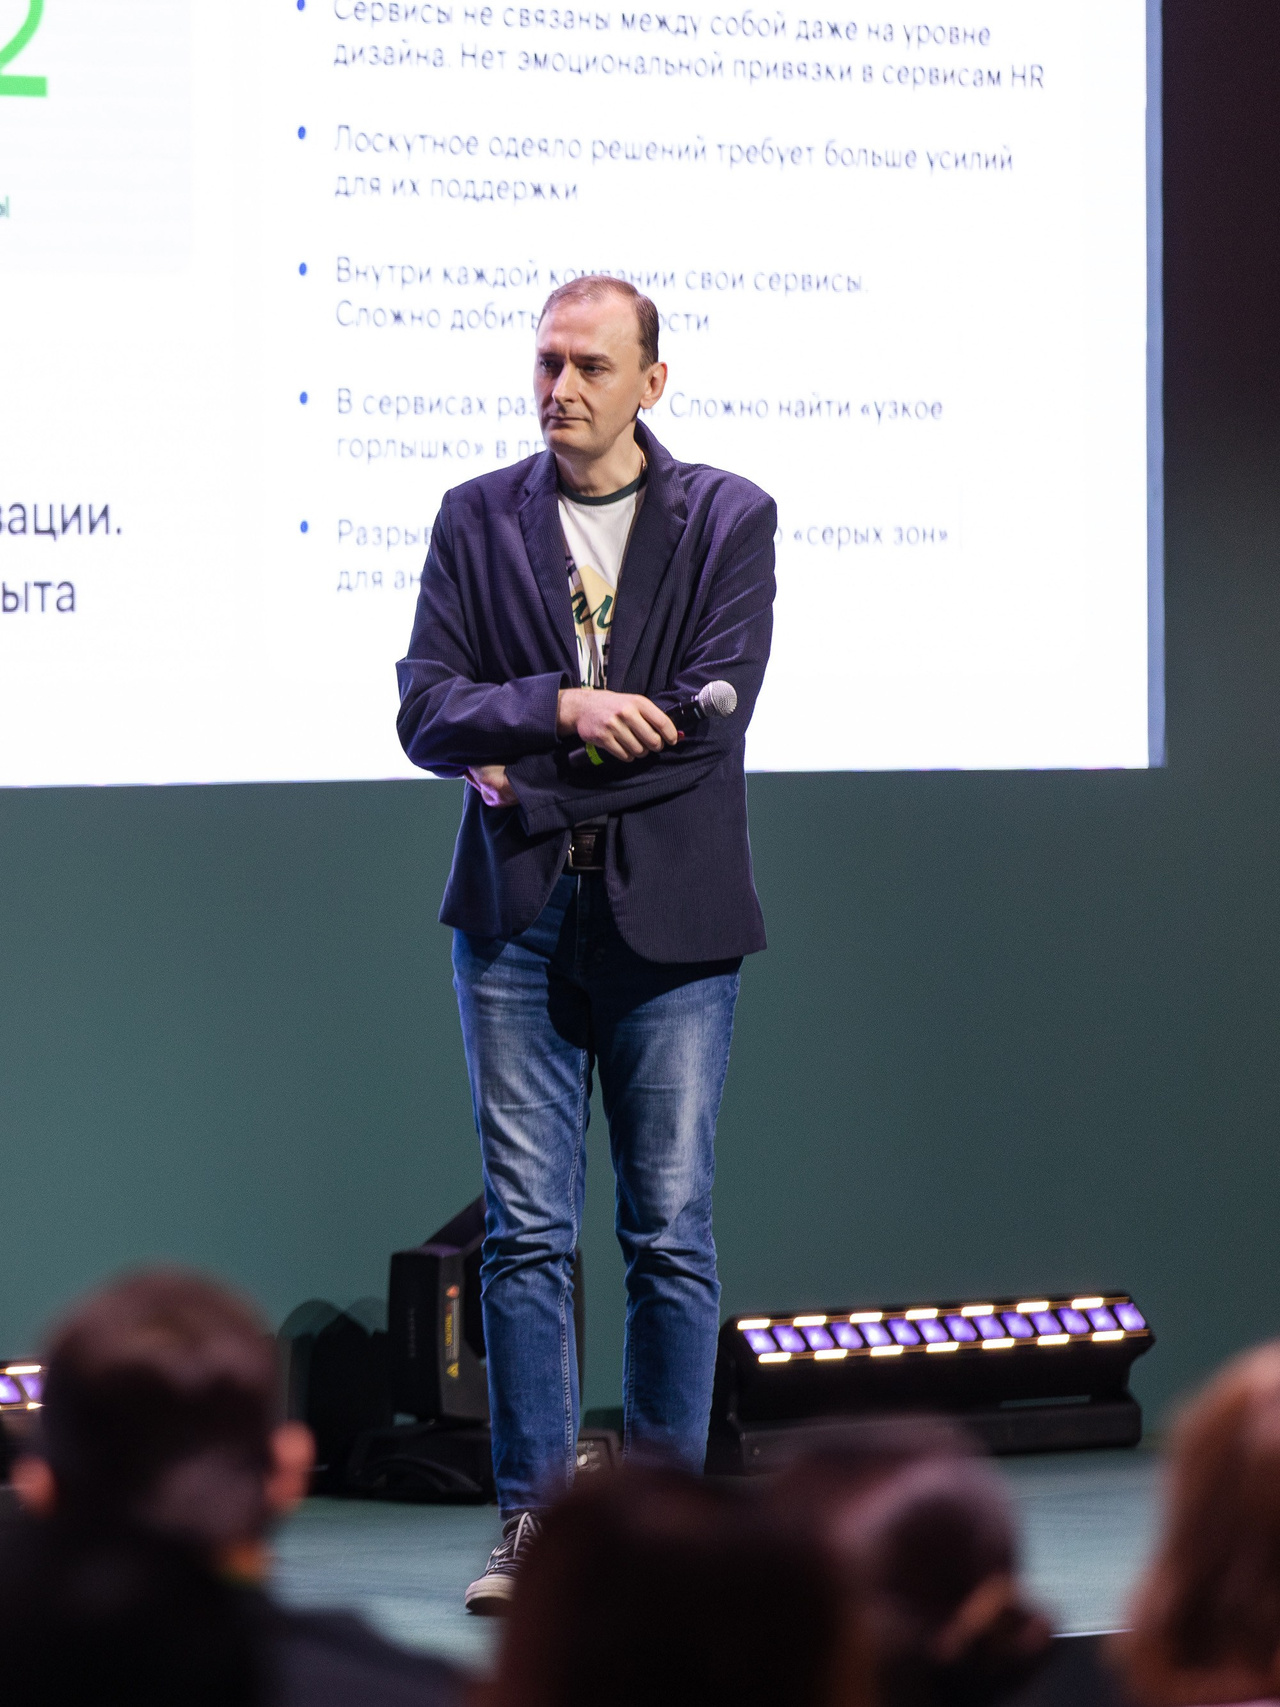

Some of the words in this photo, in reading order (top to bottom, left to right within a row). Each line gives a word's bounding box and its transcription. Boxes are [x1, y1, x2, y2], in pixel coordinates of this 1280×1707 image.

[333, 0, 453, 28] Сервисы
[463, 6, 493, 27] не
[502, 7, 610, 31] связаны
[621, 12, 700, 38] между
[710, 9, 786, 38] собой
[795, 19, 858, 42] даже
[867, 23, 894, 43] на
[902, 24, 991, 48] уровне
[461, 43, 507, 70] Нет
[517, 50, 724, 78] эмоциональной
[733, 57, 852, 84] привязки
[862, 63, 874, 83] в
[882, 64, 1002, 90] сервисам
[1011, 64, 1045, 89] HR
[334, 124, 479, 160] Лоскутное
[488, 136, 582, 160] одеяло
[591, 135, 706, 165] решений
[716, 137, 814, 170] требует
[824, 140, 918, 170] больше
[925, 145, 1013, 177] усилий
[334, 175, 381, 198] для
[392, 178, 420, 197] их
[431, 178, 578, 206] поддержки
[336, 255, 432, 289] Внутри
[442, 259, 539, 289] каждой
[685, 270, 745, 291] свои
[335, 299, 441, 329] Сложно
[337, 387, 353, 415] В
[362, 394, 487, 422] сервисах
[669, 391, 769, 419] Сложно
[778, 393, 851, 419] найти
[495, 439, 507, 459] в
[336, 570, 383, 593] для
